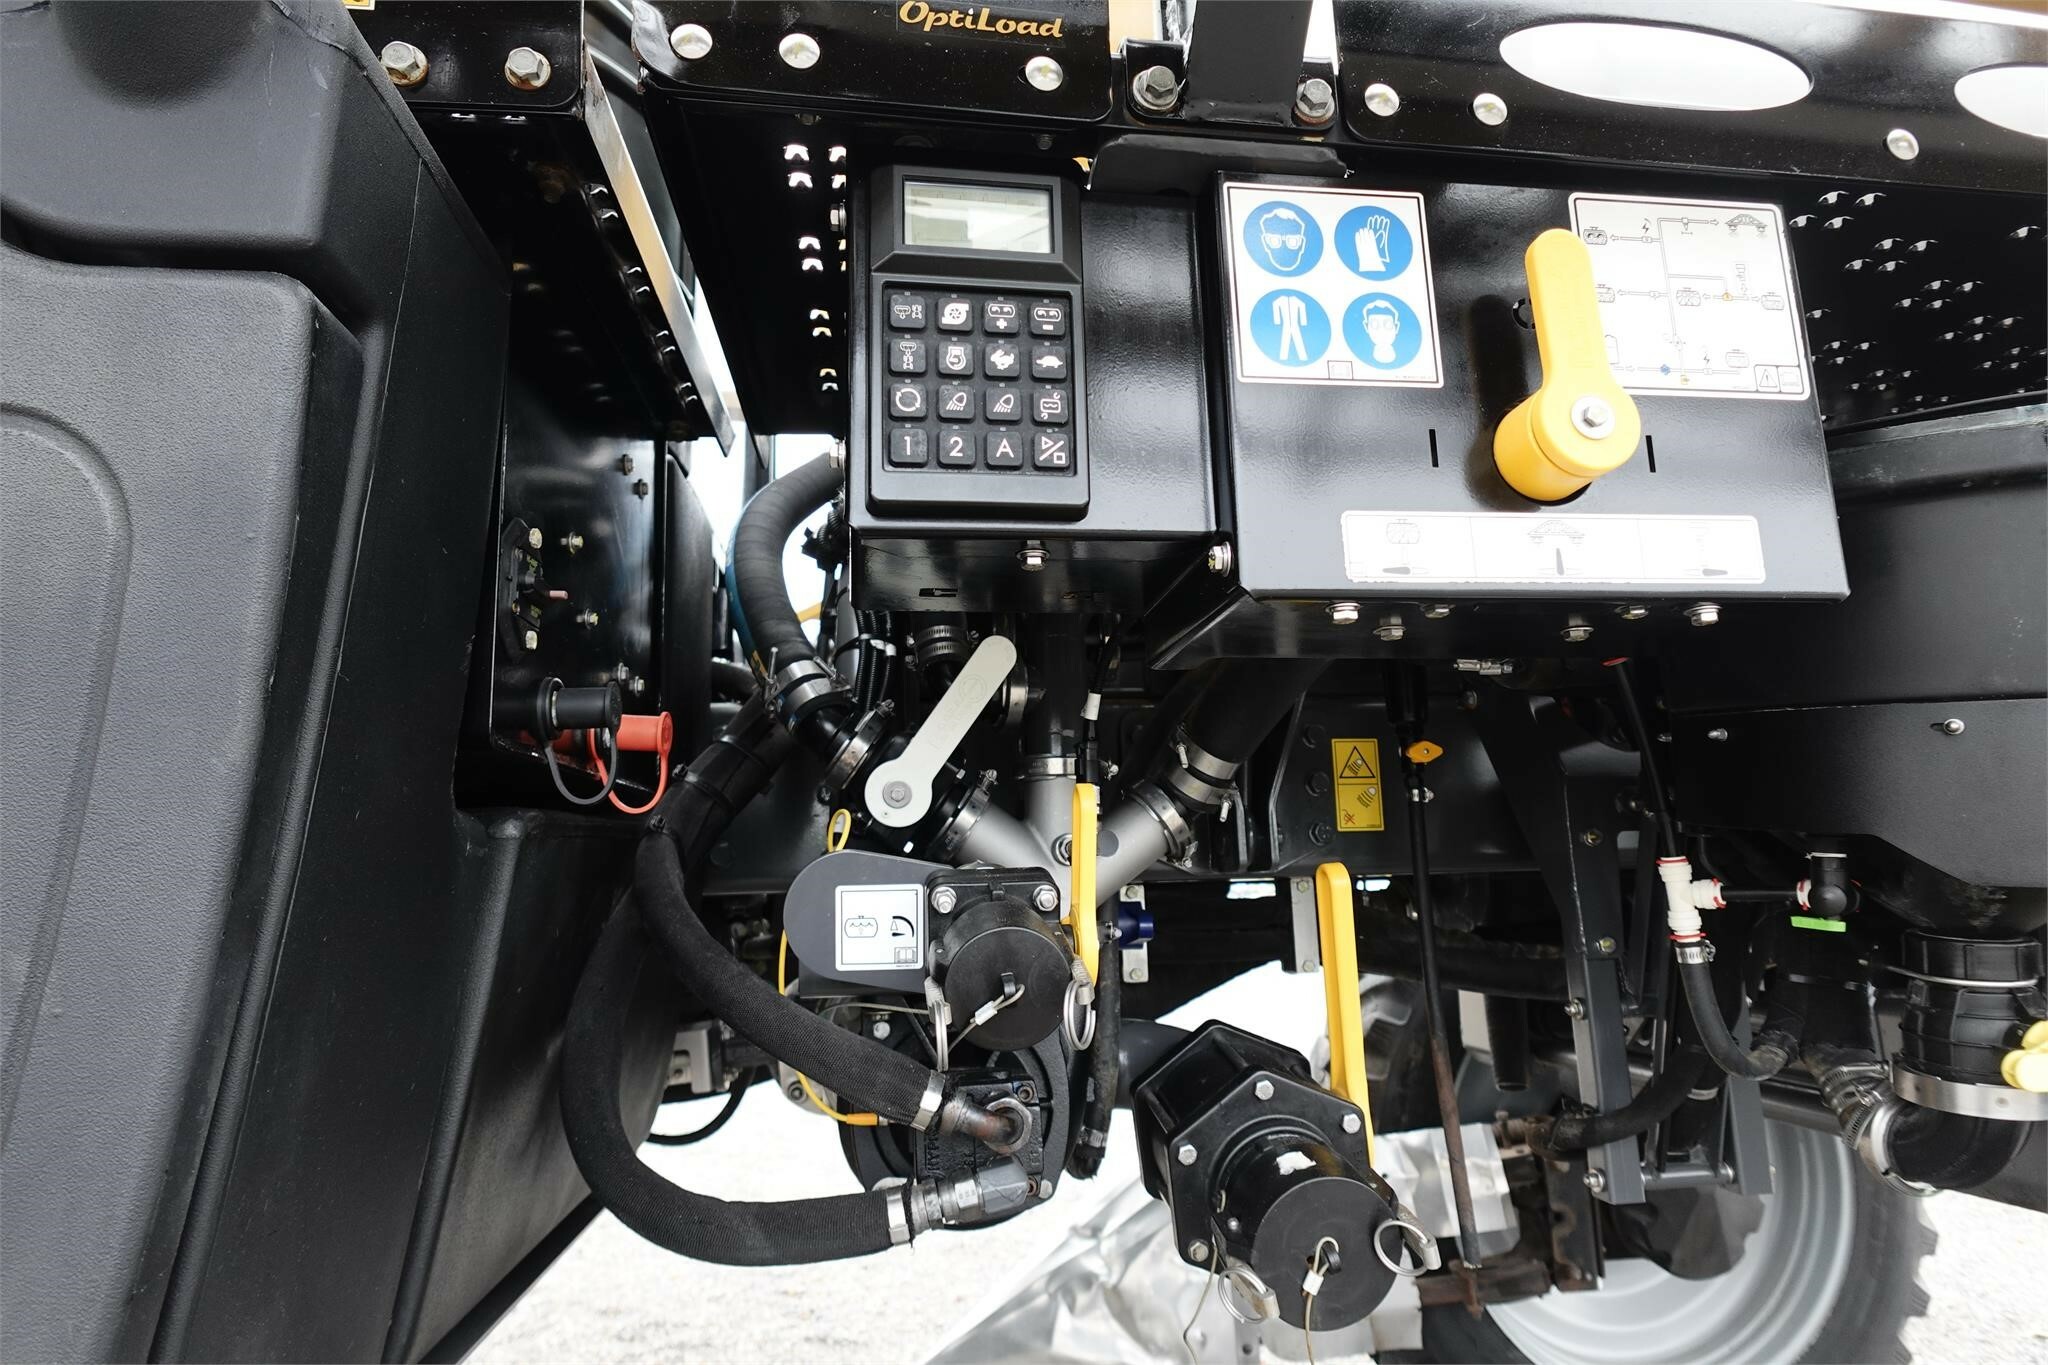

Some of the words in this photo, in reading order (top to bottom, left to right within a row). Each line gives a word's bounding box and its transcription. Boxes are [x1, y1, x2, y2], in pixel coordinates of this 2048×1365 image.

[899, 0, 1063, 38] OptiLoad
[903, 435, 911, 456] 1
[949, 436, 964, 457] 2
[995, 437, 1015, 459] A
